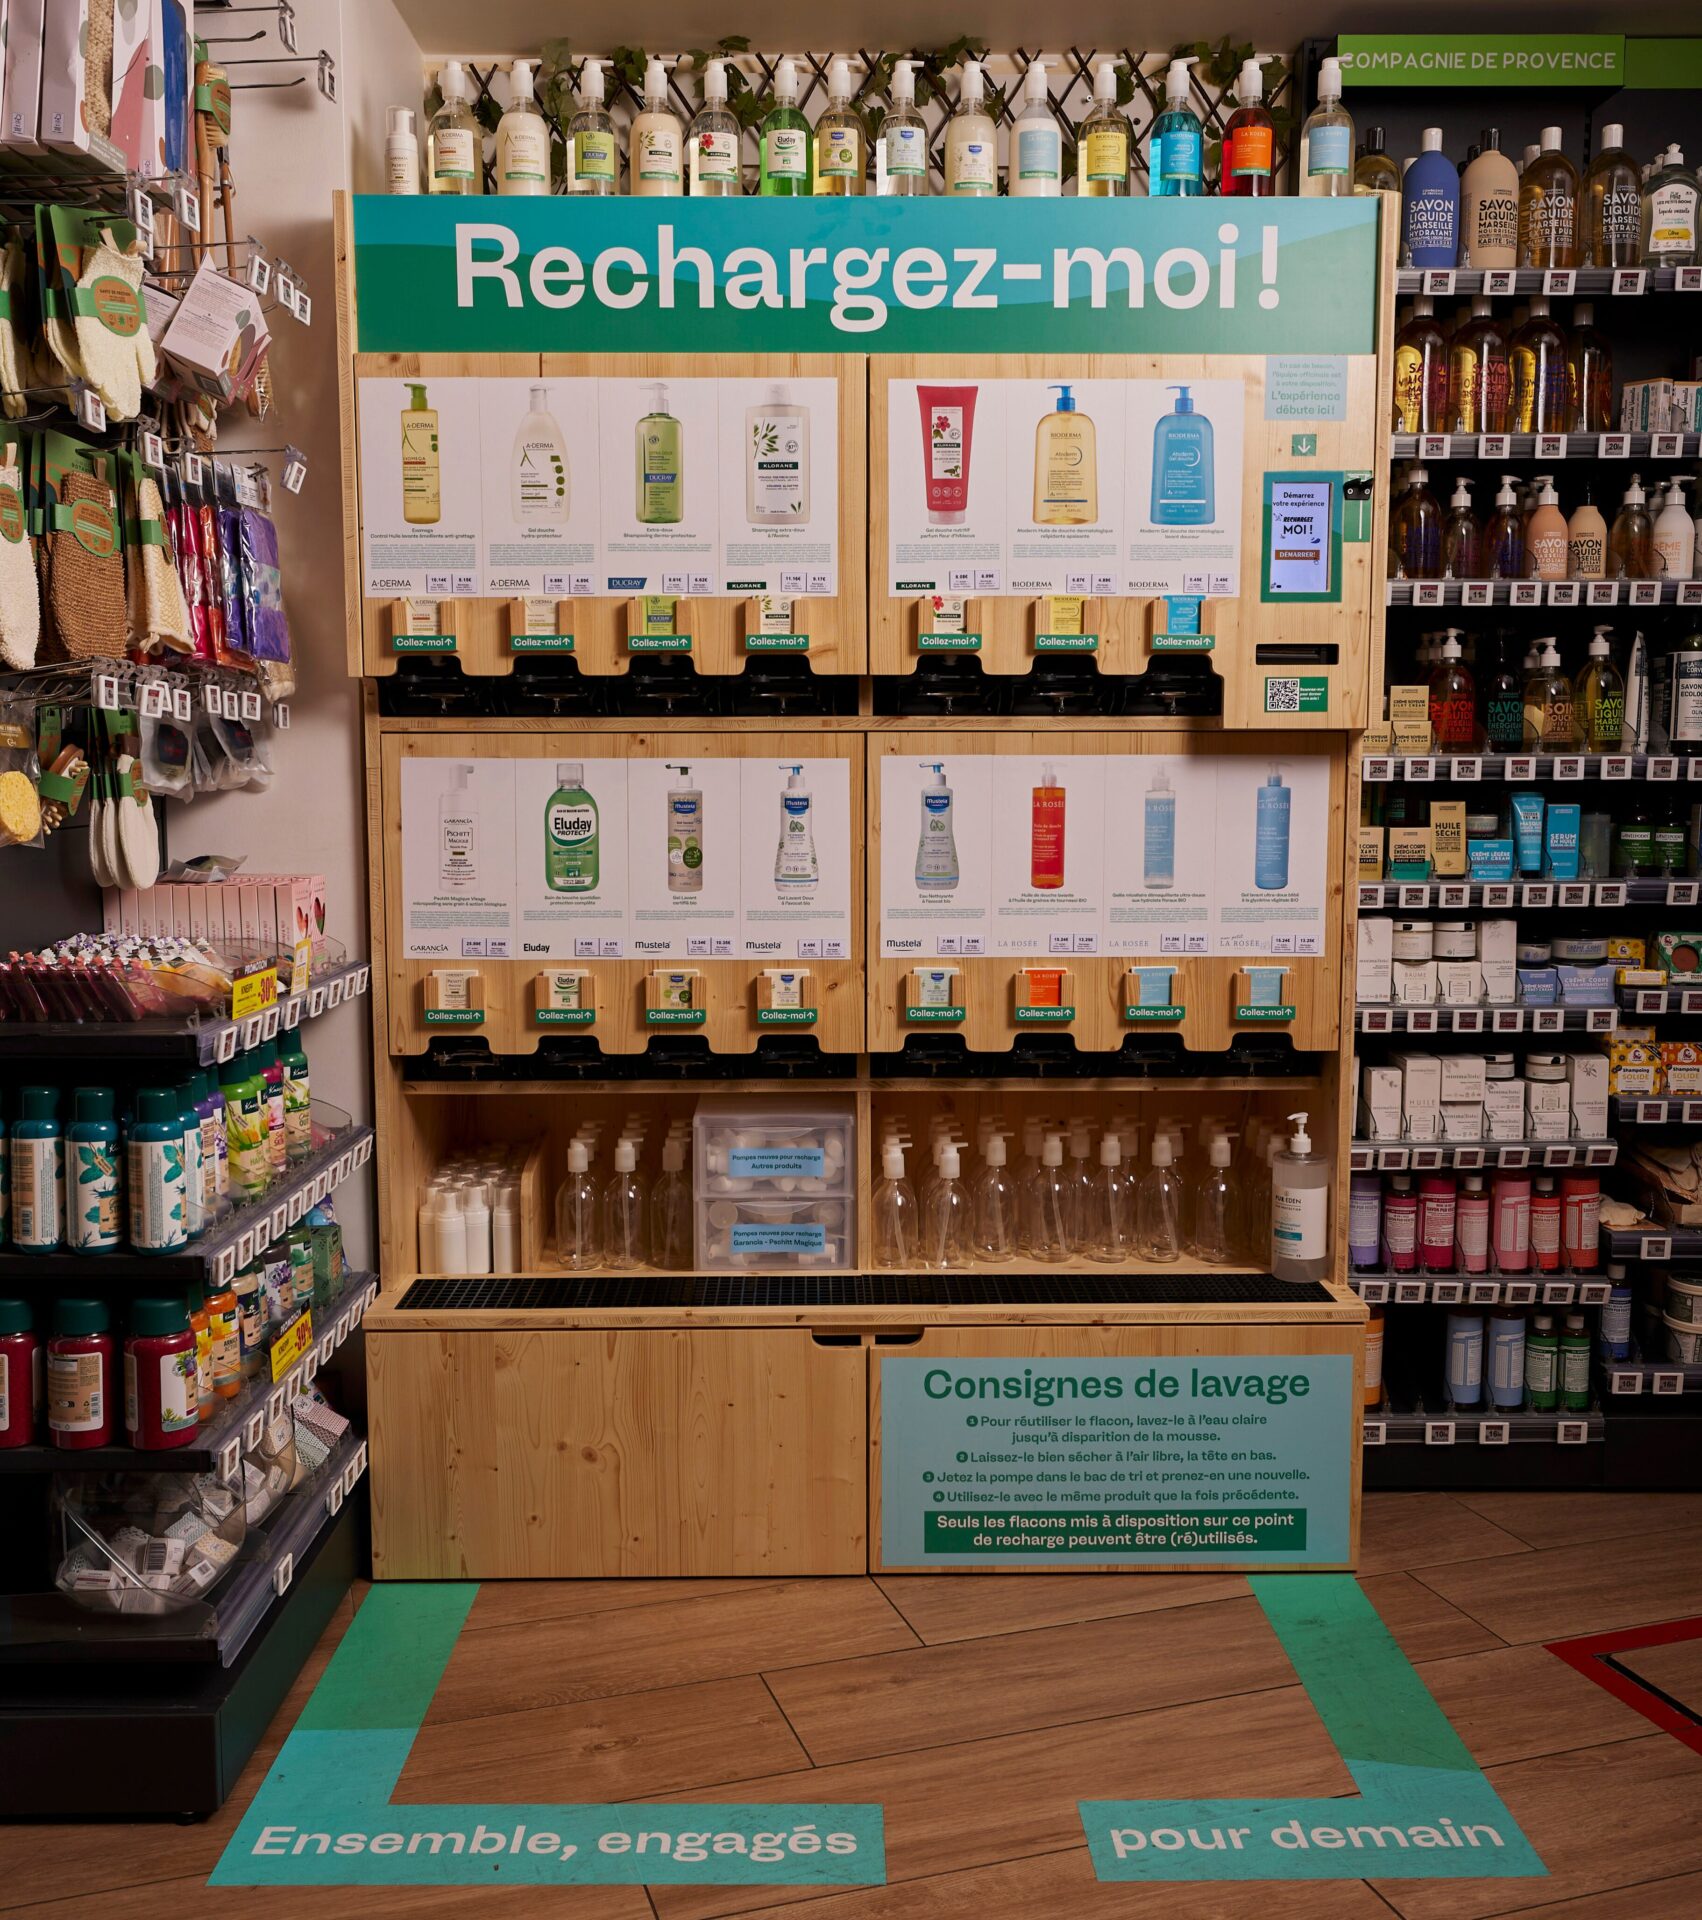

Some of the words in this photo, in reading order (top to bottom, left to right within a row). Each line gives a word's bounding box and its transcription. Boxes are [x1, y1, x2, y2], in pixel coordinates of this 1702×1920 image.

[1342, 52, 1466, 68] COMPAGNIE
[1472, 52, 1497, 68] DE
[1503, 52, 1616, 69] PROVENCE
[1410, 200, 1453, 212] SAVON
[1480, 200, 1517, 211] SAVON
[1530, 197, 1573, 210] SAVON
[1410, 212, 1453, 223] LIQUIDE
[1530, 210, 1573, 221] LIQUIDE
[1410, 222, 1452, 231] MARSEILLE
[1272, 391, 1341, 402] L'expérience
[1276, 405, 1314, 414] débute
[1284, 525, 1306, 534] MOI
[1534, 539, 1567, 548] SAVON
[396, 638, 444, 646] Collez-moi
[514, 637, 561, 646] Collez-moi
[632, 638, 679, 647] Collez-moi
[749, 637, 796, 645] Collez-moi
[922, 637, 969, 645] Collez-moi
[1039, 637, 1086, 646] Collez-moi
[1156, 637, 1202, 646] Collez-moi
[554, 817, 592, 832] Eluday
[1435, 822, 1461, 830] HUILE
[635, 941, 670, 949] Mustela
[746, 941, 781, 949] Mustela
[887, 939, 921, 947] Mustela
[524, 943, 550, 953] Eluday
[428, 1012, 472, 1020] Collez-moi
[649, 1011, 694, 1019] Collez-moi
[910, 1009, 954, 1017] Collez-moi
[1019, 1009, 1063, 1017] Collez-moi
[1129, 1008, 1173, 1016] Collez-moi
[1240, 1008, 1284, 1016] Collez-moi
[794, 1239, 822, 1247] Magique
[924, 1369, 1123, 1407] Consignes
[1134, 1368, 1179, 1398] de
[1191, 1368, 1310, 1405] lavage
[981, 1416, 1011, 1427] Pour
[1014, 1416, 1072, 1427] réutiliser
[1075, 1416, 1086, 1426] le
[1089, 1416, 1134, 1428] flacon,
[1137, 1415, 1185, 1426] lavez-le
[1188, 1414, 1196, 1425] à
[1199, 1414, 1228, 1425] l'eau
[1232, 1414, 1267, 1425] claire
[1012, 1432, 1059, 1445] jusqu'à
[1061, 1431, 1130, 1445] disparition
[1133, 1431, 1149, 1442] de
[1152, 1431, 1164, 1442] la
[1167, 1433, 1221, 1441] mousse.
[971, 1452, 1034, 1463] Laissez-le
[1038, 1451, 1065, 1462] bien
[1068, 1451, 1112, 1462] sécher
[1115, 1451, 1123, 1462] à
[1126, 1451, 1149, 1462] l'air
[1153, 1450, 1184, 1463] libre,
[1187, 1450, 1198, 1461] la
[1201, 1450, 1228, 1461] tête
[1231, 1452, 1247, 1461] en
[1250, 1450, 1276, 1460] bas.
[937, 1472, 973, 1482] Jetez
[976, 1472, 987, 1482] la
[990, 1474, 1033, 1484] pompe
[1036, 1472, 1067, 1482] dans
[1070, 1471, 1081, 1482] le
[1084, 1471, 1107, 1482] bac
[1110, 1471, 1125, 1482] de
[1128, 1470, 1143, 1481] tri
[1146, 1472, 1159, 1481] et
[1162, 1472, 1225, 1484] prenez-en
[1228, 1472, 1252, 1480] une
[1255, 1469, 1310, 1480] nouvelle.
[947, 1491, 1010, 1502] Utilisez-le
[1014, 1494, 1043, 1502] avec
[1047, 1491, 1057, 1502] le
[1061, 1491, 1101, 1501] même
[1104, 1490, 1151, 1503] produit
[1154, 1493, 1177, 1503] que
[1181, 1490, 1192, 1501] la
[1195, 1489, 1219, 1501] fois
[1222, 1489, 1299, 1503] précédente.
[937, 1515, 980, 1528] Seuls
[984, 1515, 1005, 1528] les
[1009, 1515, 1066, 1528] flacons
[1071, 1515, 1098, 1527] mis
[1102, 1514, 1111, 1527] à
[1115, 1514, 1199, 1529] disposition
[1203, 1517, 1228, 1526] sur
[1232, 1516, 1250, 1526] ce
[1255, 1513, 1294, 1529] point
[973, 1533, 992, 1546] de
[996, 1533, 1064, 1547] recharge
[1069, 1533, 1131, 1547] peuvent
[1135, 1529, 1166, 1545] être
[1171, 1531, 1258, 1547] (ré)utilisés.
[1109, 1825, 1250, 1858] pour
[1270, 1817, 1505, 1849] demain
[252, 1824, 579, 1862] Ensemble,
[597, 1824, 857, 1862] engagés
